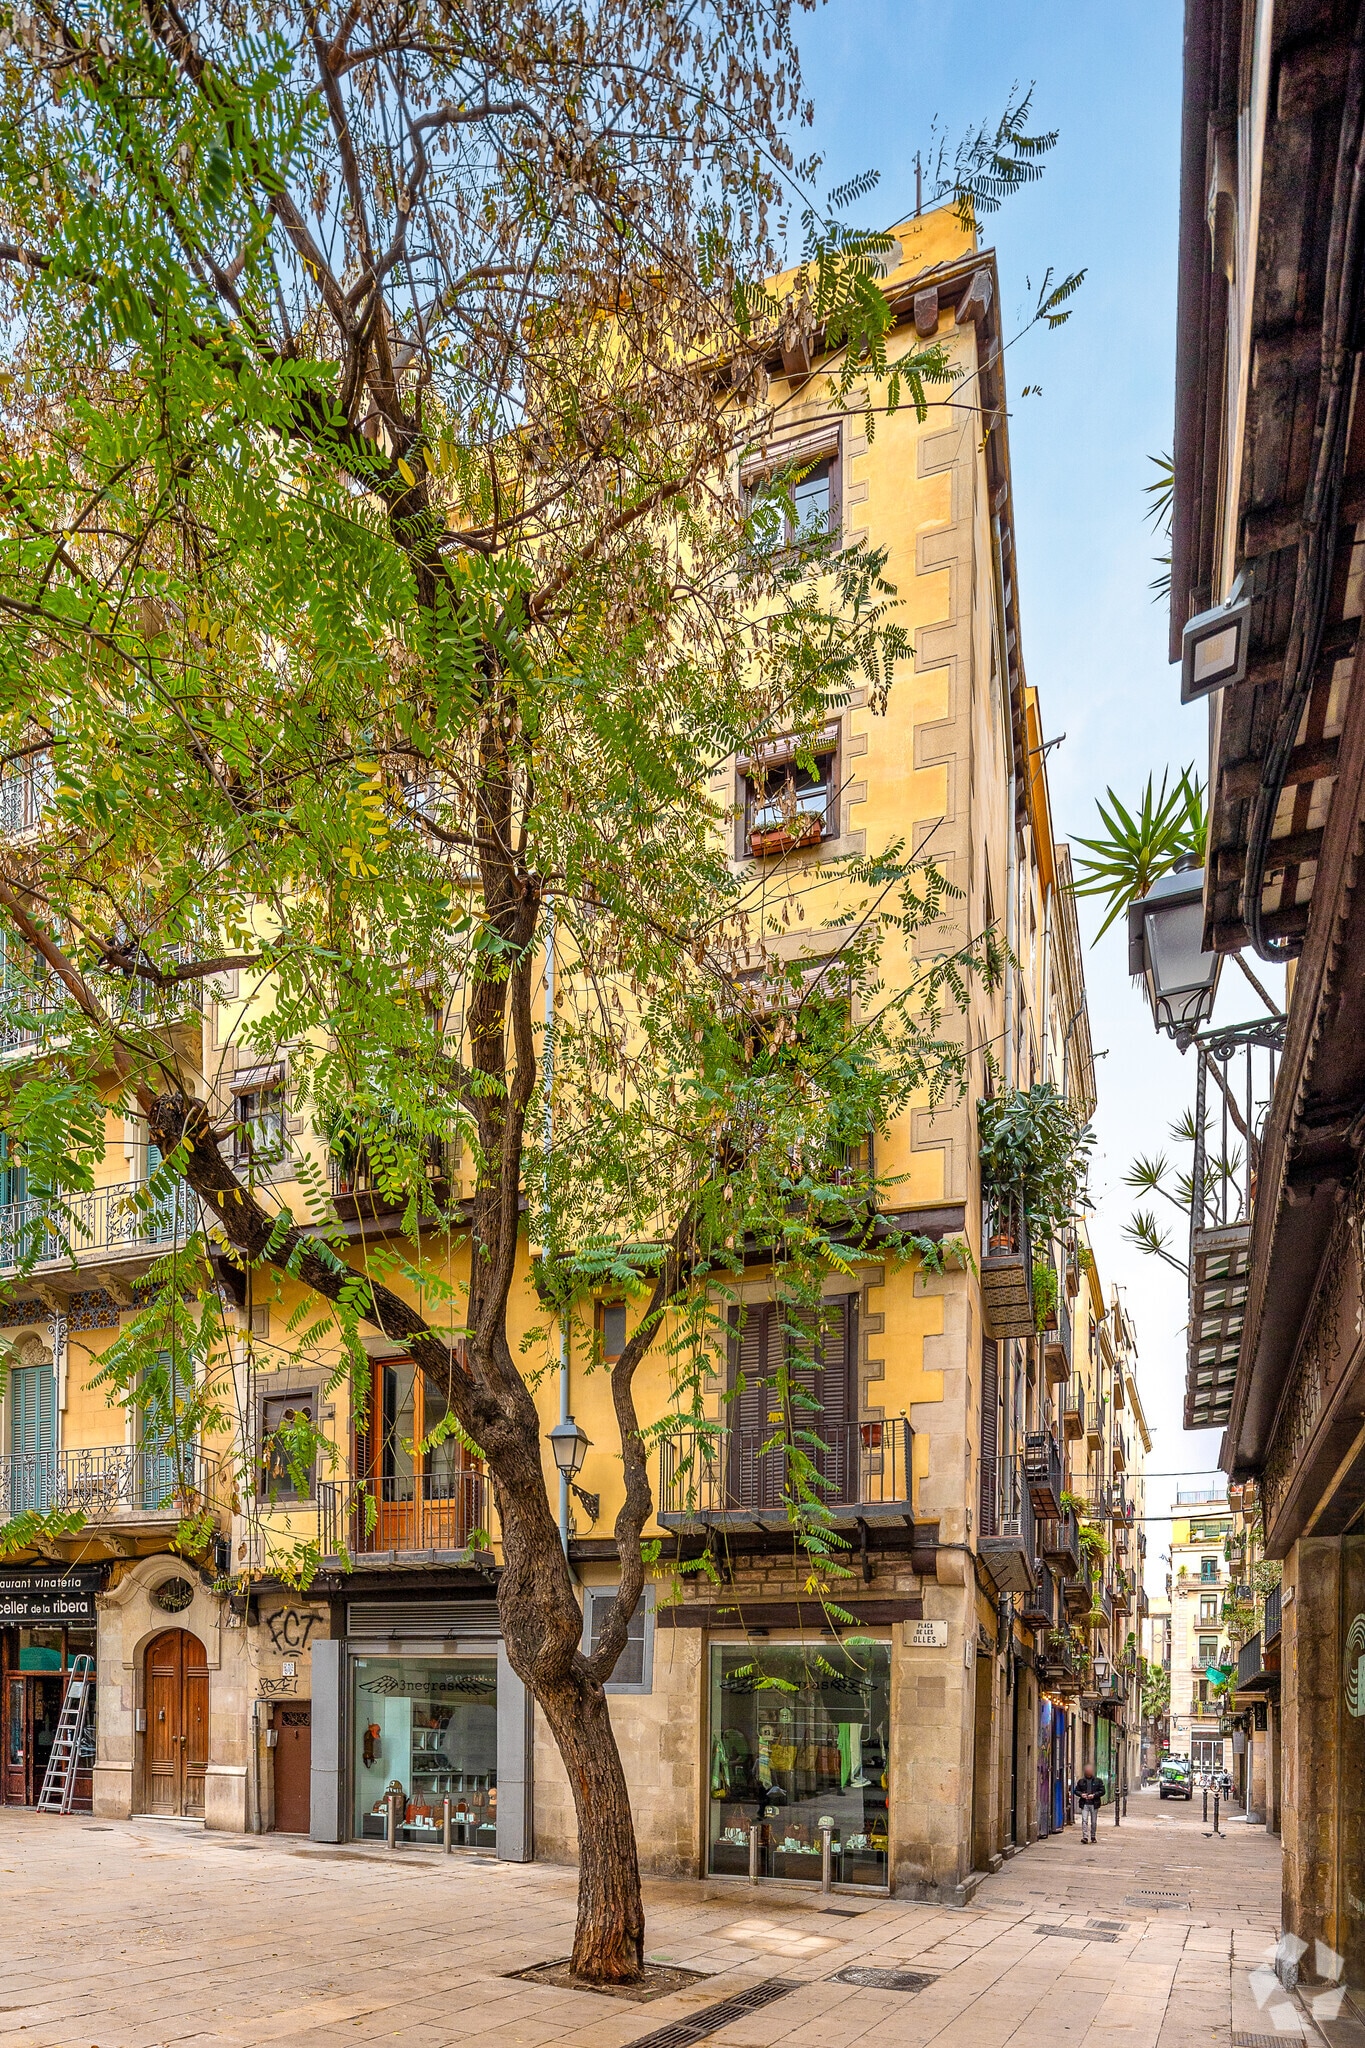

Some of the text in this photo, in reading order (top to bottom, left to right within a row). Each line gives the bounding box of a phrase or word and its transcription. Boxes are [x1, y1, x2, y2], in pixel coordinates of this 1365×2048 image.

[30, 1604, 42, 1614] de
[42, 1603, 51, 1613] la
[53, 1600, 88, 1613] ribera
[913, 1636, 937, 1644] OLLES
[400, 1679, 454, 1693] 3negras
